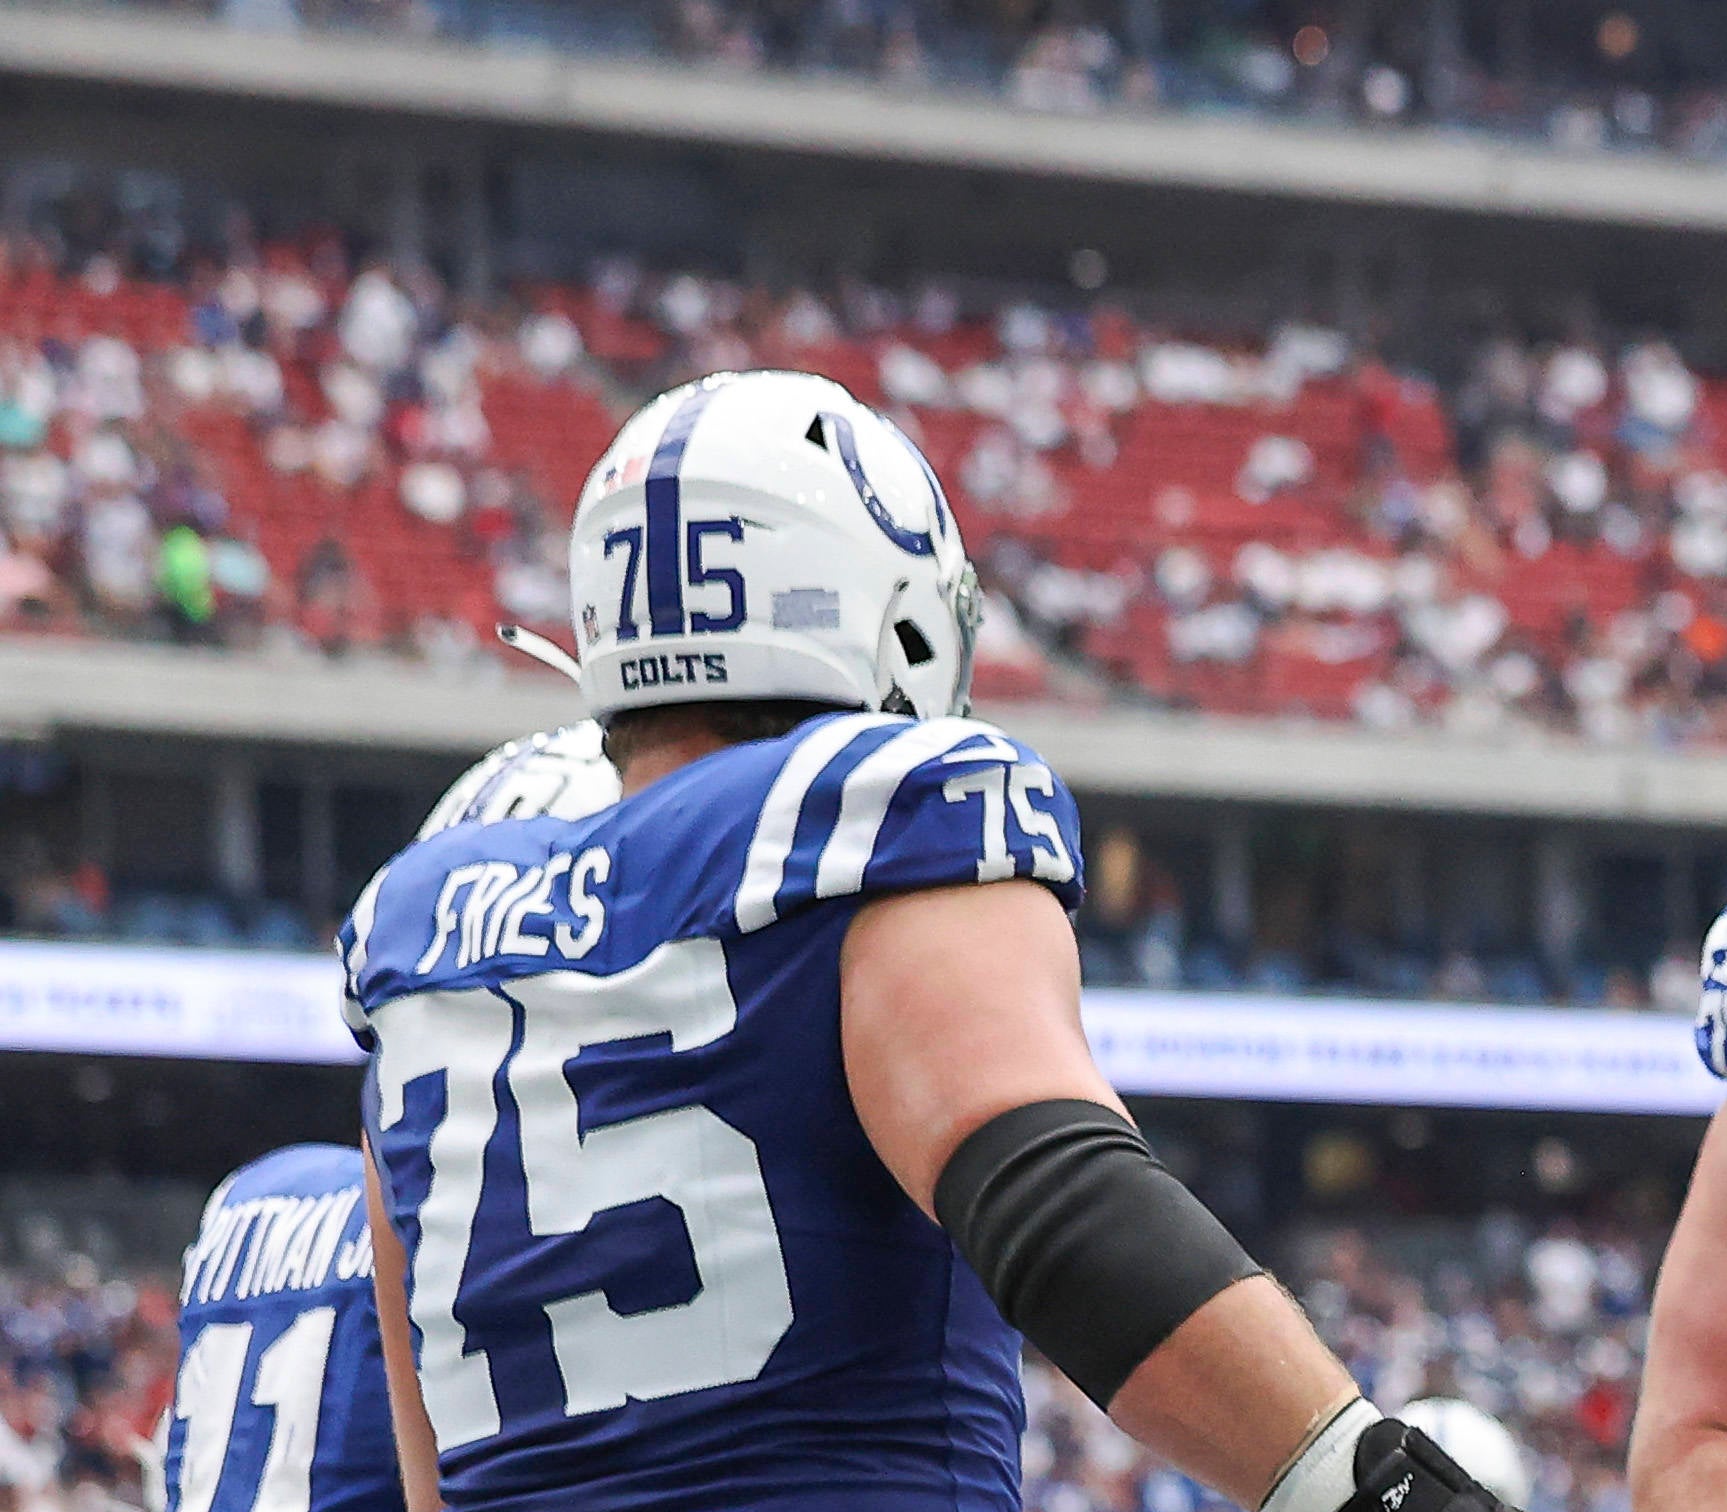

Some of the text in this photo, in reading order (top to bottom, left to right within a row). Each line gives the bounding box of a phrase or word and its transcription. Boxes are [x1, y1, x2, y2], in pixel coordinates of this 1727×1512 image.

[604, 515, 747, 641] 75
[620, 653, 728, 690] COLTS
[943, 761, 1076, 884] 75
[416, 846, 612, 975] FRIES
[179, 1185, 362, 1307] PITTMAN
[365, 937, 797, 1453] 75
